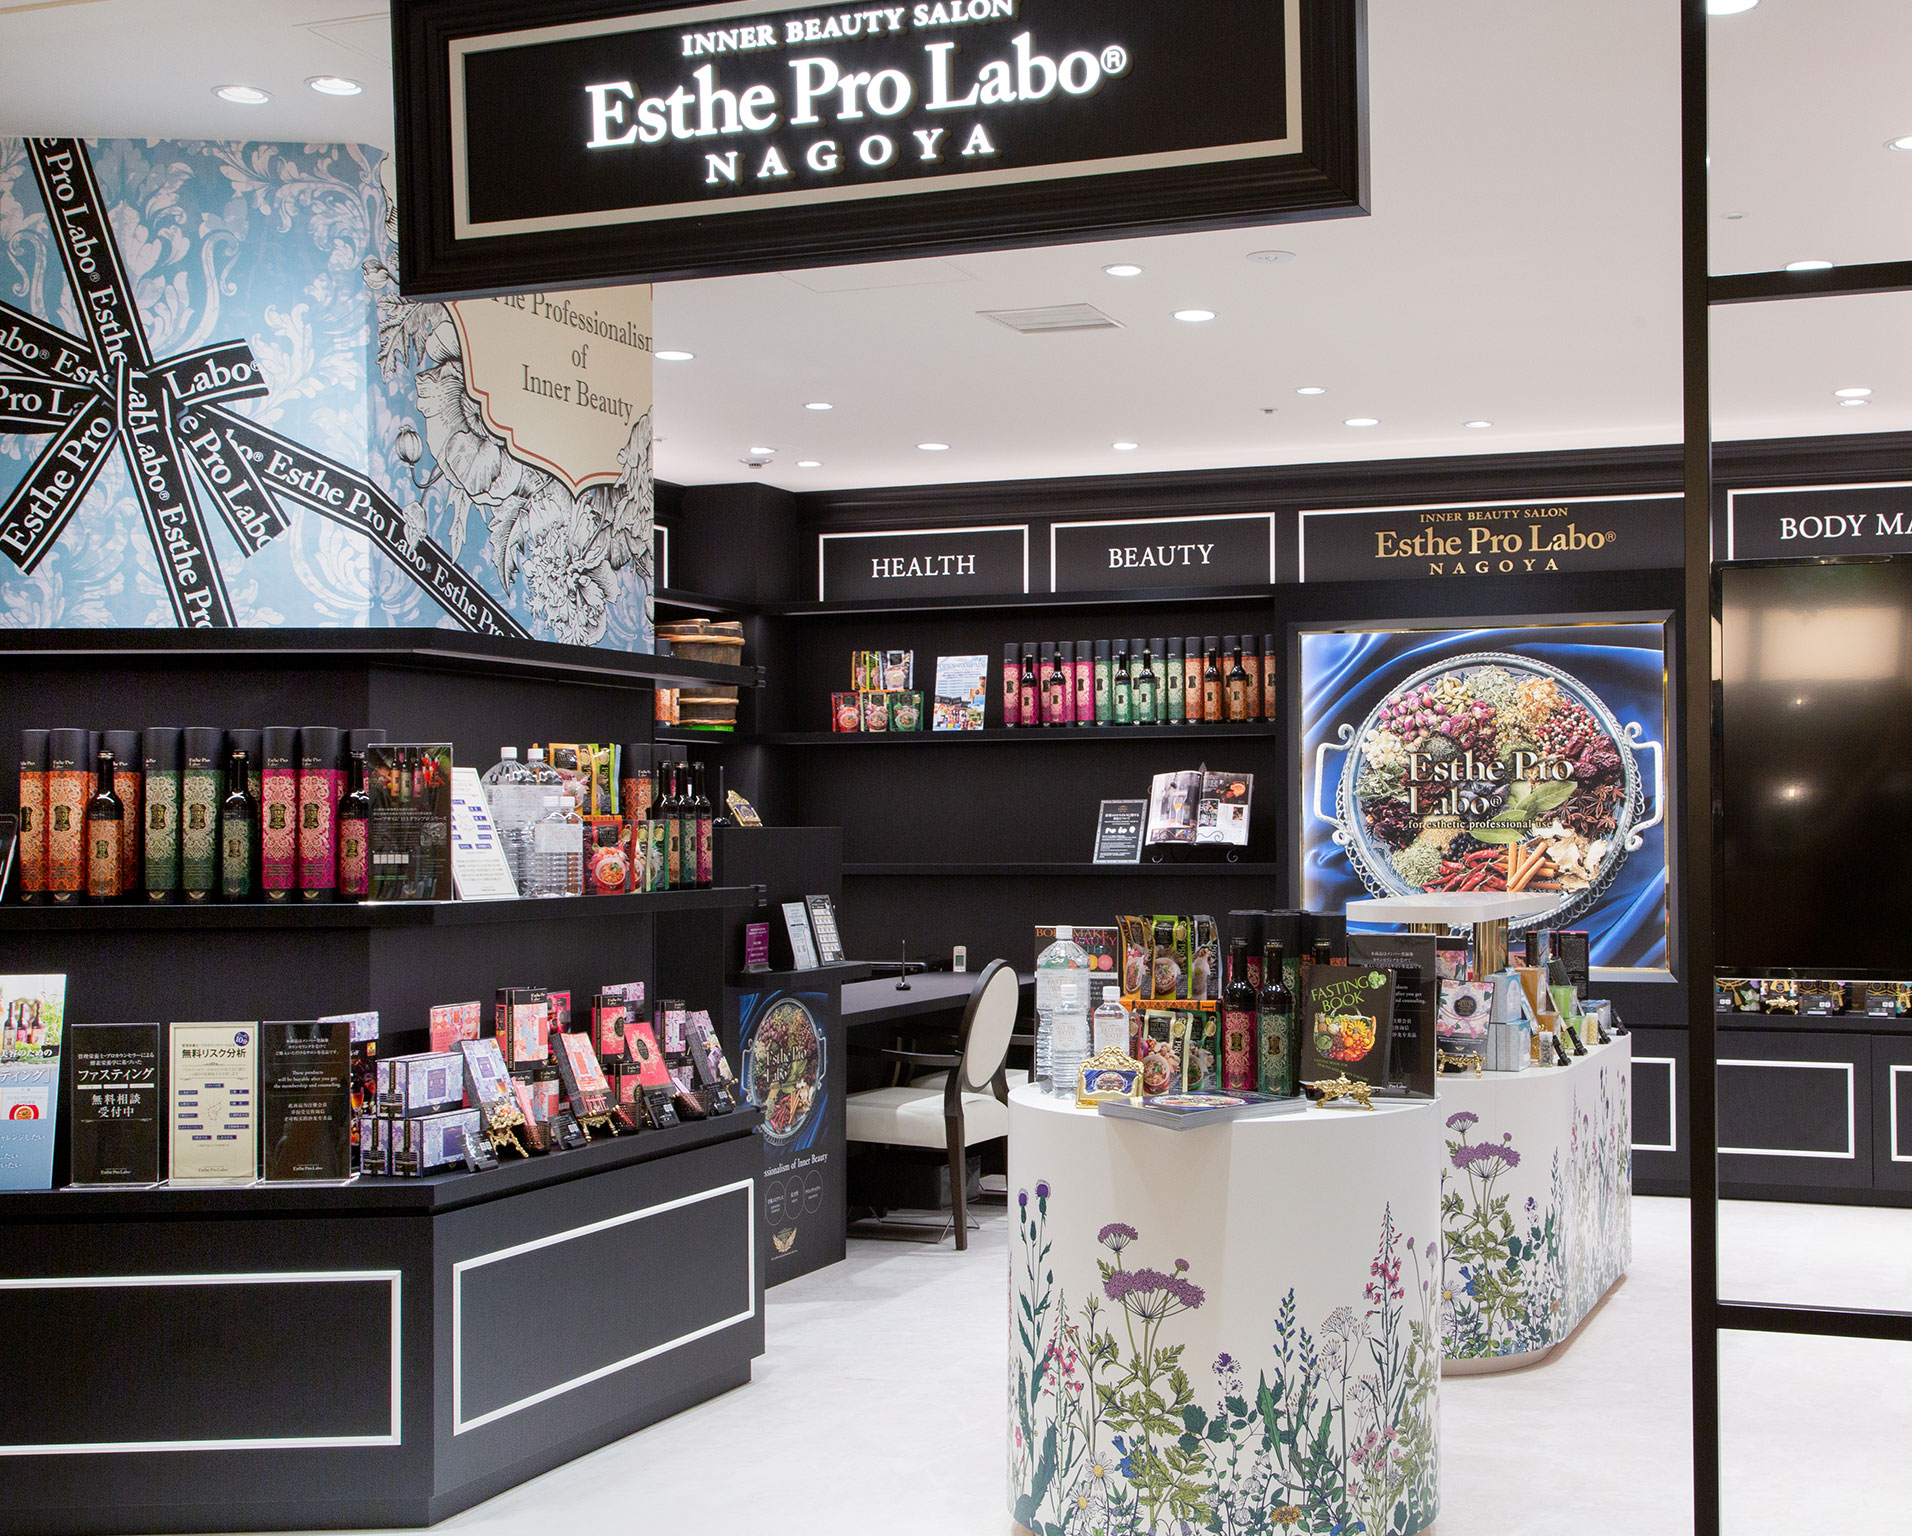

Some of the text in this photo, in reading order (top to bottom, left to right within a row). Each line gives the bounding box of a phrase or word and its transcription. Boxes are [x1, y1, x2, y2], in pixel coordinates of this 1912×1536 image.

[681, 0, 1014, 56] INNER BEAUTY SALON
[584, 65, 777, 150] Esthe
[790, 54, 912, 126] Pro
[704, 124, 997, 185] NAGOYA
[45, 148, 75, 212] Pro
[88, 284, 131, 366] Esthe
[571, 344, 590, 370] of
[128, 368, 158, 427] Lab
[521, 363, 634, 426] Inner Beauty
[190, 428, 232, 484] Pro
[2, 467, 76, 558] Esthe
[58, 417, 112, 472] Pro
[1419, 507, 1569, 524] INNER BEAUTY SALON
[1779, 514, 1867, 541] BODY
[157, 502, 200, 587] Esthe
[264, 449, 345, 506] Esthe
[345, 488, 386, 532] Pro
[433, 562, 478, 621] Esthe
[1374, 529, 1463, 560] Esthe
[1468, 525, 1524, 557] Pro
[870, 554, 976, 579] HEALTH
[1108, 542, 1215, 569] BEAUTY
[1428, 557, 1561, 577] NAGOYA
[1407, 750, 1574, 783] Esthe Pro
[1408, 819, 1554, 831] for esthetic professional use
[1310, 975, 1369, 1002] FASTING
[1322, 990, 1365, 1013] BOOK
[181, 1048, 247, 1059] 無料リスク分析
[78, 1067, 155, 1082] ファスティング
[91, 1093, 142, 1107] 無料相談
[97, 1106, 135, 1118] 受付中
[791, 1158, 798, 1169] of
[797, 1156, 812, 1169] Inner
[811, 1153, 829, 1165] Beauty
